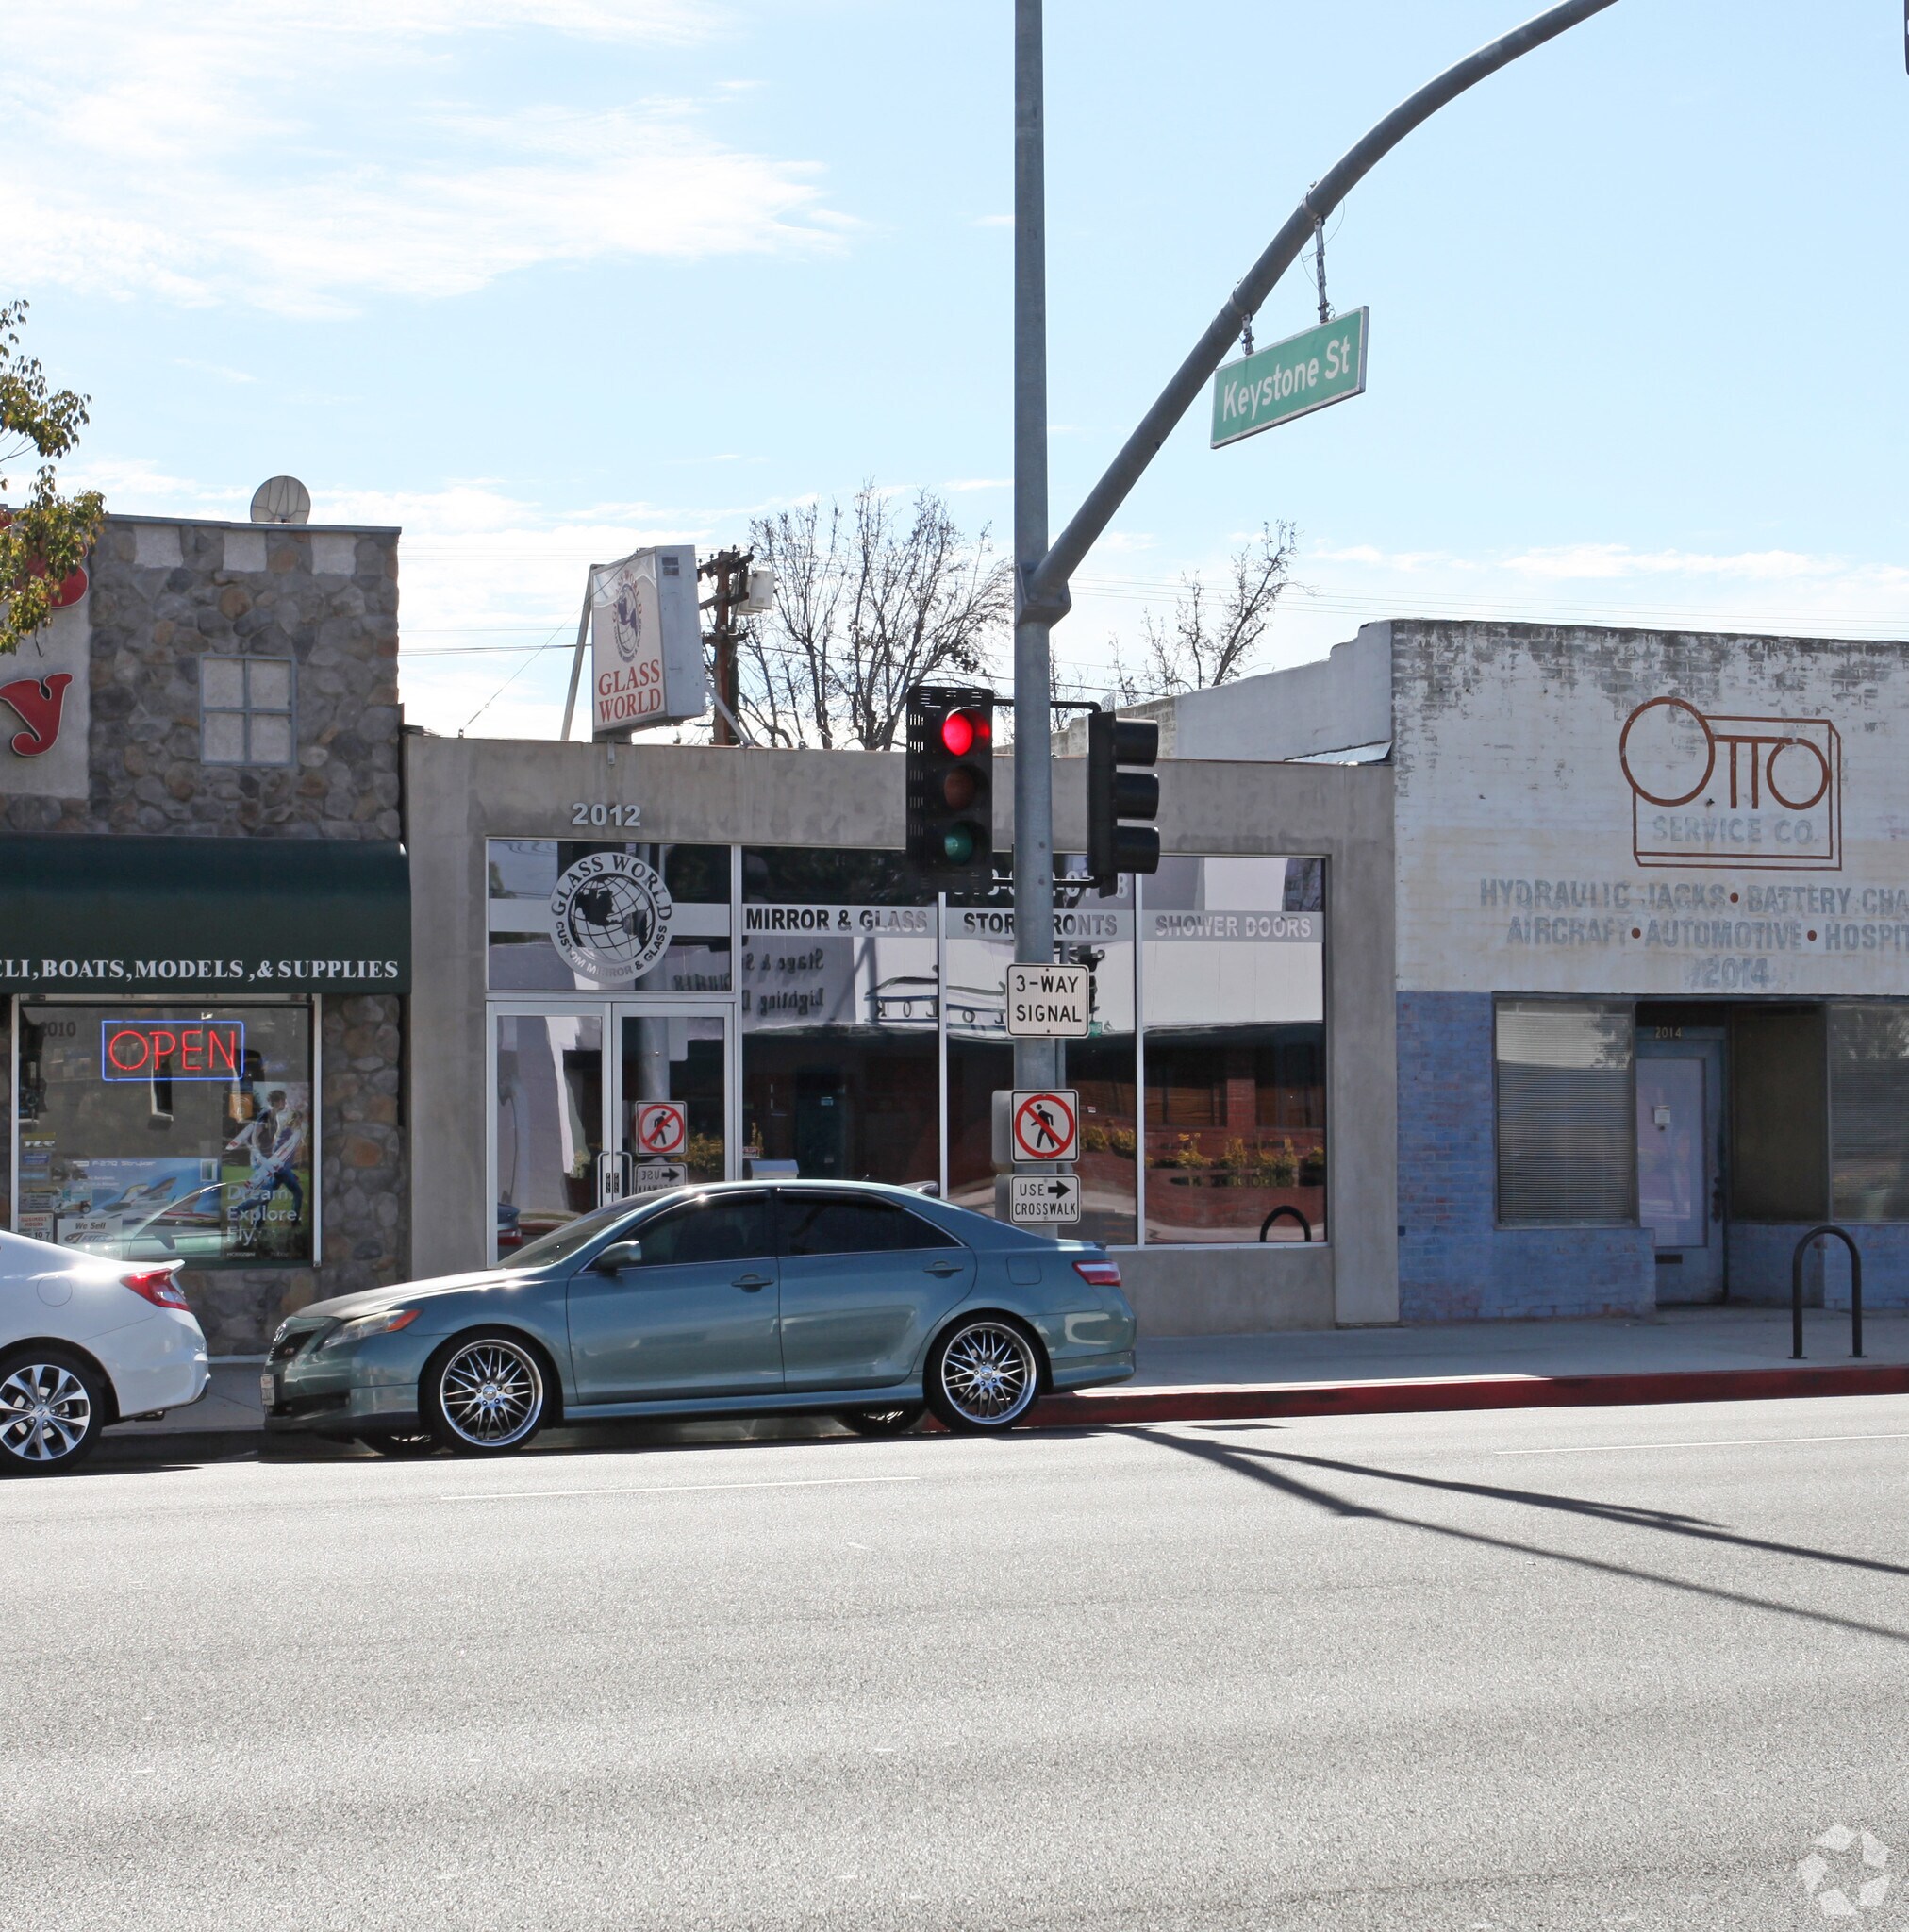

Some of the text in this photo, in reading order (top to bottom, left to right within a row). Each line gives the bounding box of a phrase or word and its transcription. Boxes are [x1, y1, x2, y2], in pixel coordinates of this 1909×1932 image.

[1223, 335, 1351, 422] Keystone St
[598, 659, 660, 696] GLASS
[599, 688, 660, 723] WORLD
[572, 802, 641, 827] 2012
[1653, 815, 1819, 845] SERVICE CO.
[551, 854, 672, 921] GLASS WORLD
[1480, 878, 1631, 910] HYDRAULIC
[1648, 882, 1726, 911] JACKS
[1747, 884, 1851, 915] BATTERY
[746, 908, 928, 933] MIRROR & GLASS
[1155, 915, 1312, 938] SHOWER DOORS
[643, 924, 669, 963] GLASS
[1507, 916, 1628, 946] AIRCRAFT
[1645, 919, 1802, 951] AUTOMOTIVE
[278, 960, 398, 979] SUPPLIES
[1016, 974, 1079, 993] 3-WAY
[1016, 1004, 1082, 1022] SIGNAL
[1655, 1026, 1683, 1038] 2014
[108, 1030, 235, 1070] OPEN
[1020, 1183, 1045, 1196] USE
[227, 1205, 302, 1225] Explore.
[1015, 1203, 1076, 1215] CROSSWALK
[76, 1222, 107, 1230] We Sell
